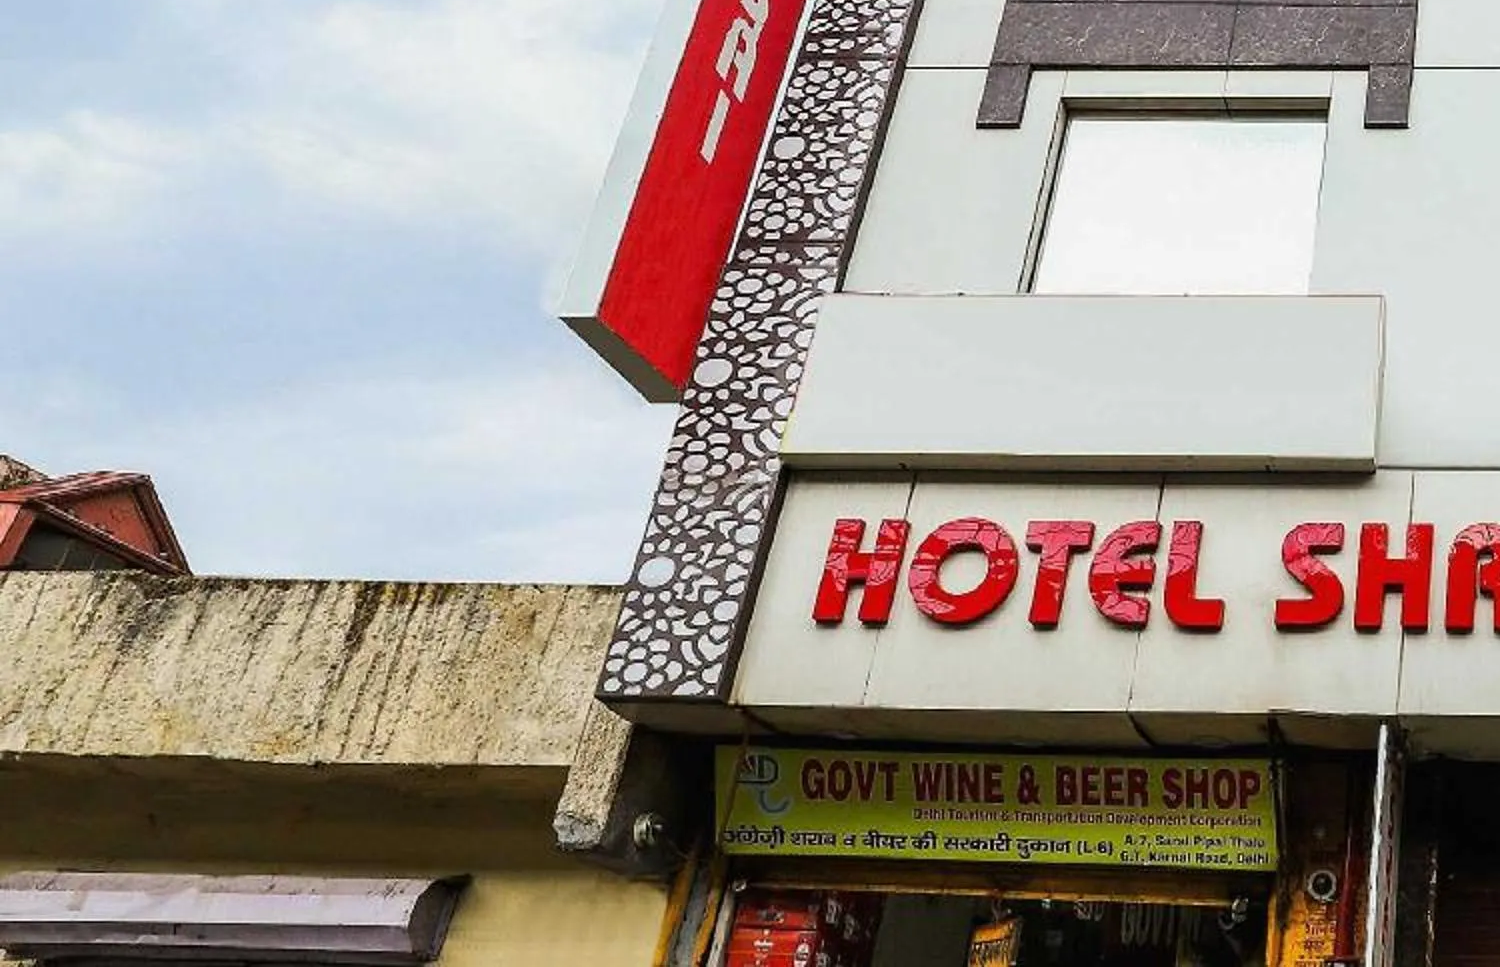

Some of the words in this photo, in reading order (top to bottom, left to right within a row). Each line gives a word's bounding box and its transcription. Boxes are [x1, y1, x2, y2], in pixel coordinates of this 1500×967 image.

[811, 517, 1225, 631] HOTEL
[800, 757, 900, 802] GOVT
[911, 761, 1005, 804] WINE
[1017, 764, 1041, 806] &
[1055, 765, 1149, 808] BEER
[1161, 767, 1261, 810] SHOP
[911, 830, 937, 850] की
